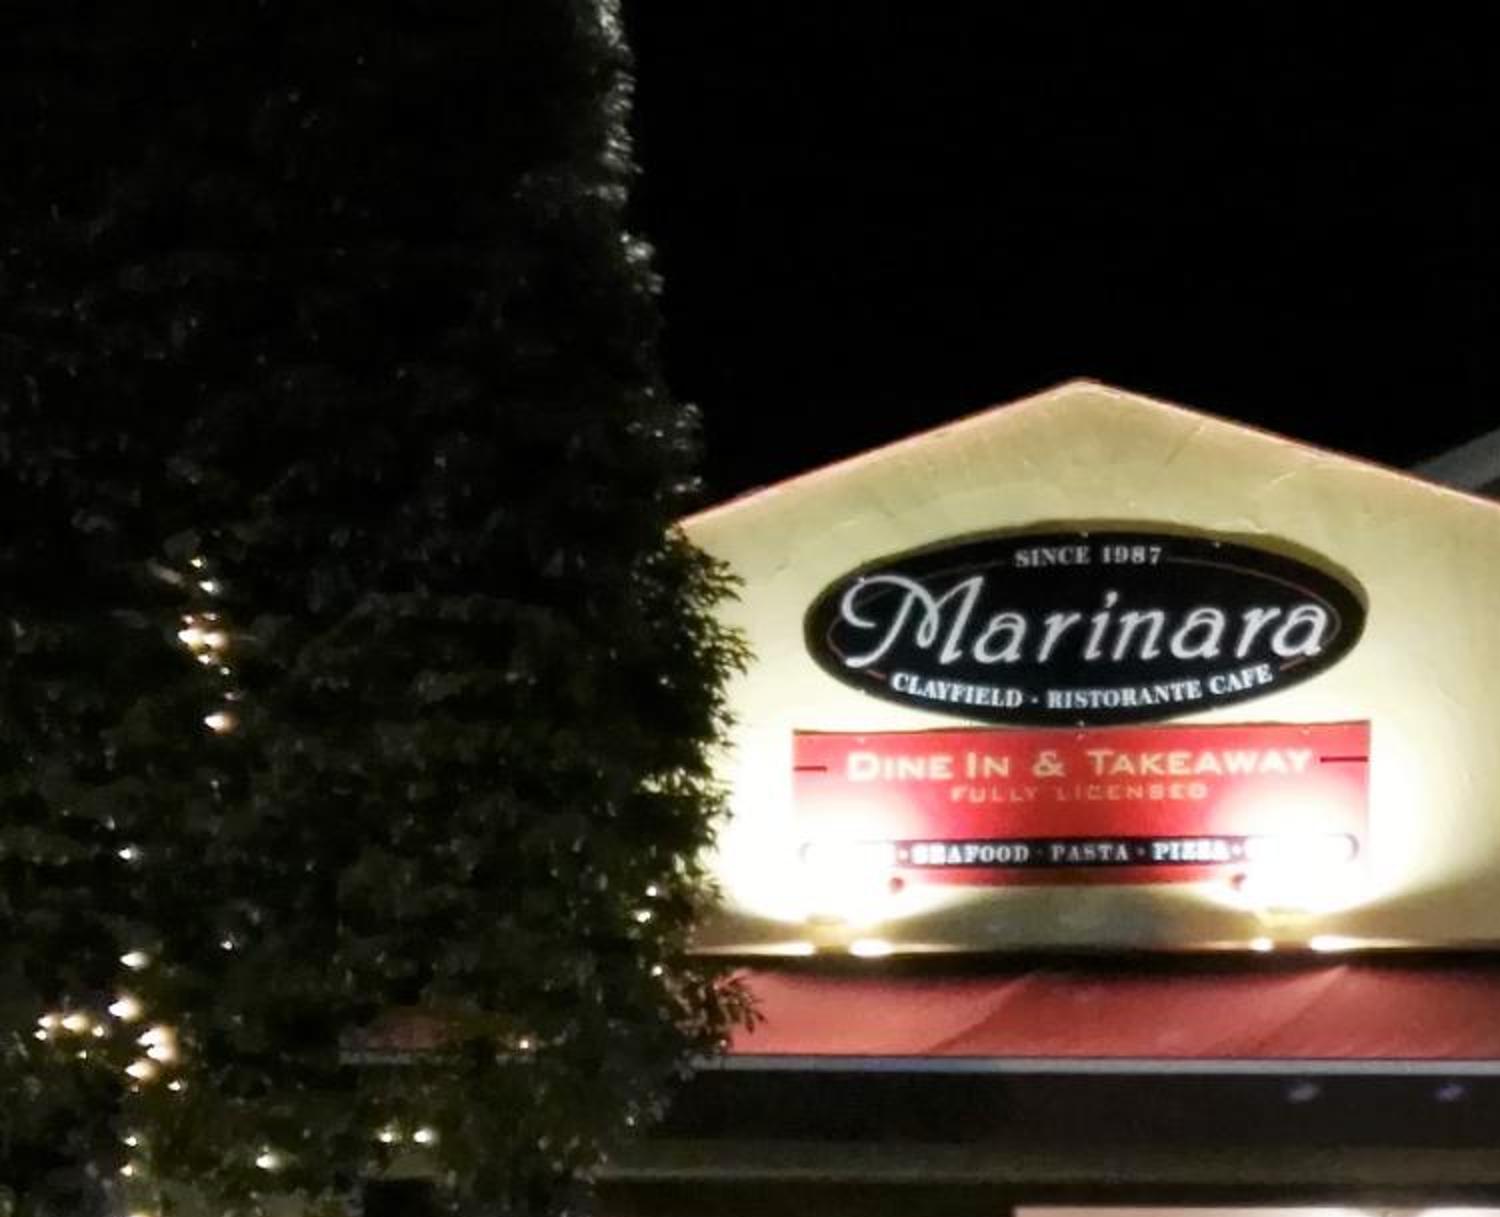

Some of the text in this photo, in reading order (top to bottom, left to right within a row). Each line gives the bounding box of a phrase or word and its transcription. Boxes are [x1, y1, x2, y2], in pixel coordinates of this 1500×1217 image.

[1014, 544, 1163, 567] SINCE 1987
[840, 574, 1328, 668] Marinara
[892, 663, 1274, 709] CLAYFIELD RISTORANTE CAFE
[848, 749, 1312, 781] DINE IN & TAKEAWAY
[952, 782, 1208, 804] FULLY LICENSED
[1052, 843, 1129, 862] PASTA
